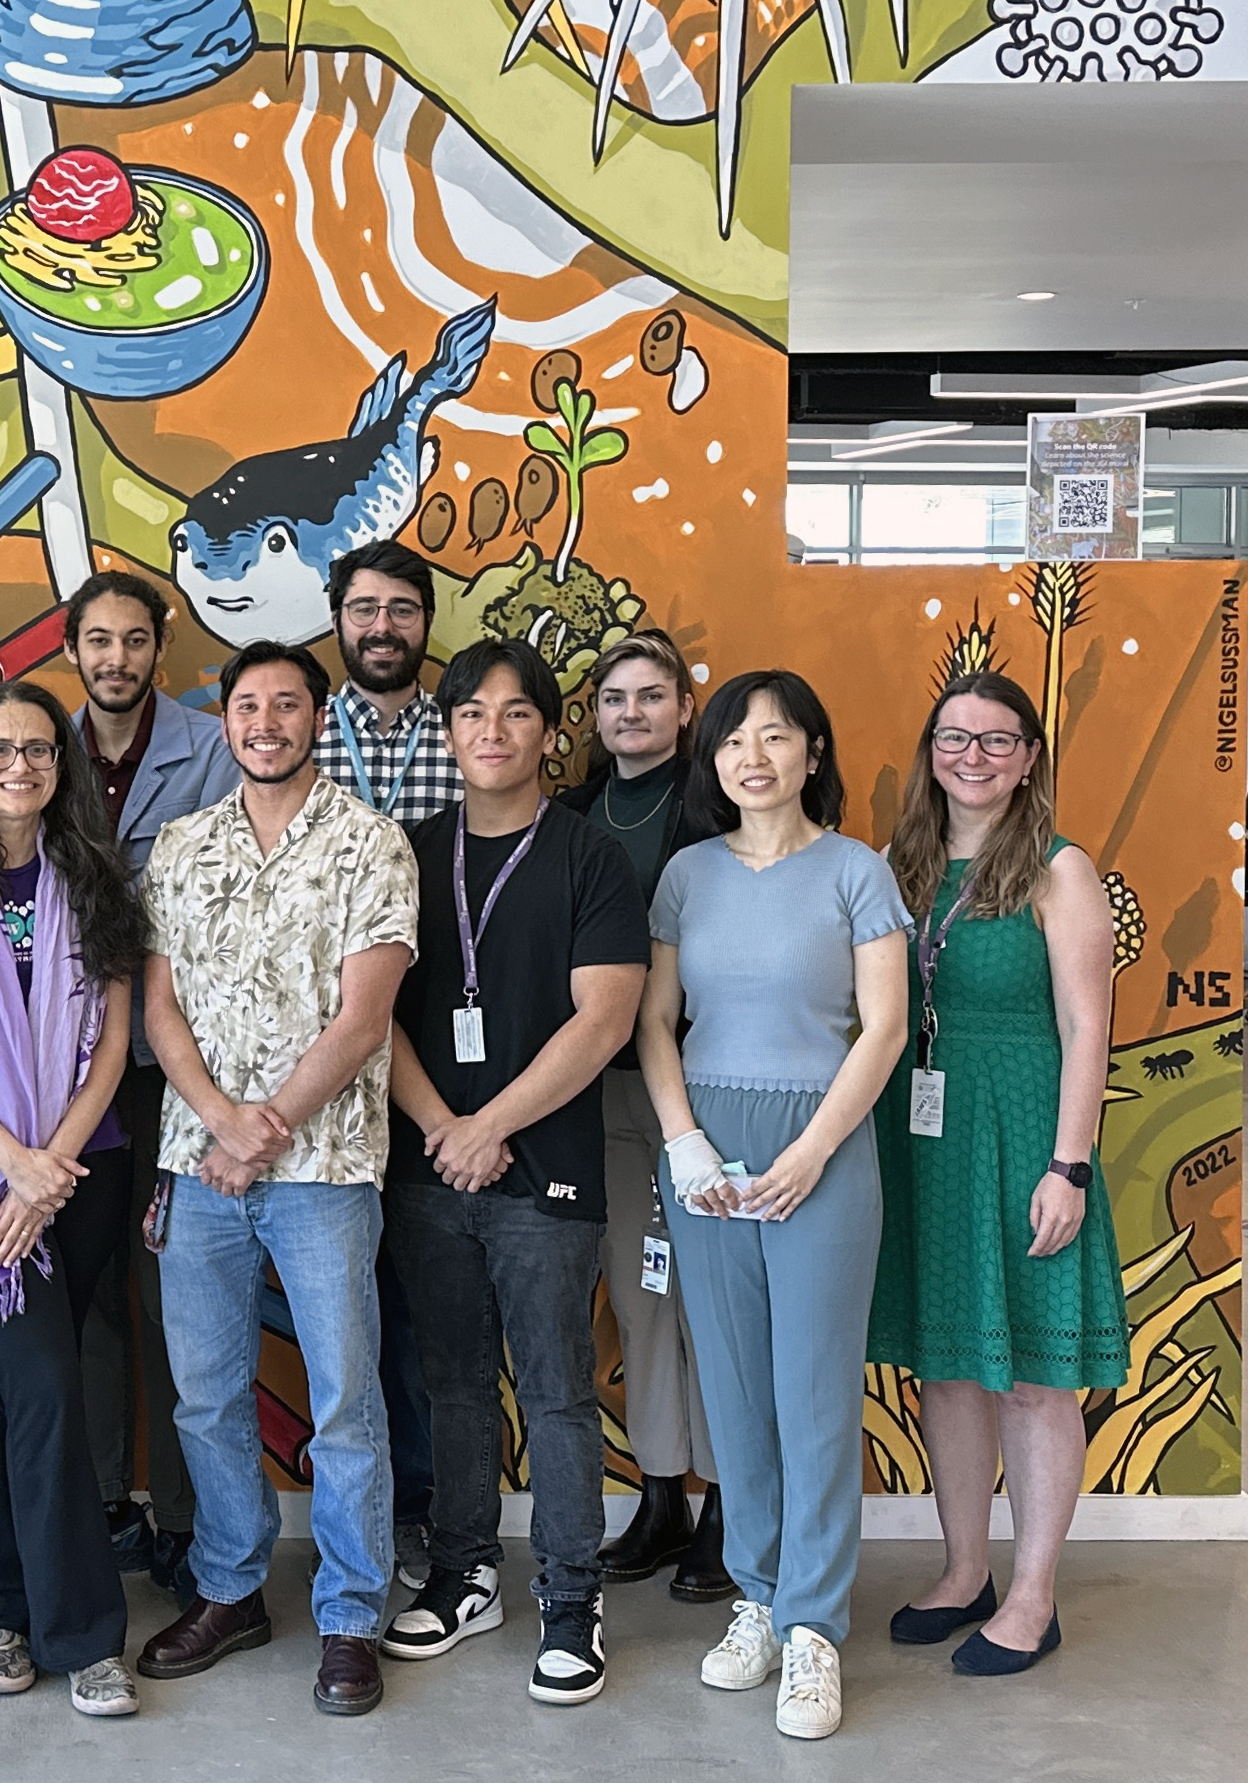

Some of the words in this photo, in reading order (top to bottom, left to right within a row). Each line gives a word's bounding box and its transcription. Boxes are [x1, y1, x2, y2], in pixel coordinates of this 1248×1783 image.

[1214, 579, 1241, 773] @NIGELSUSSMAN
[1166, 971, 1231, 1007] NS
[1182, 1144, 1237, 1187] 2022
[546, 1181, 577, 1200] UFC
